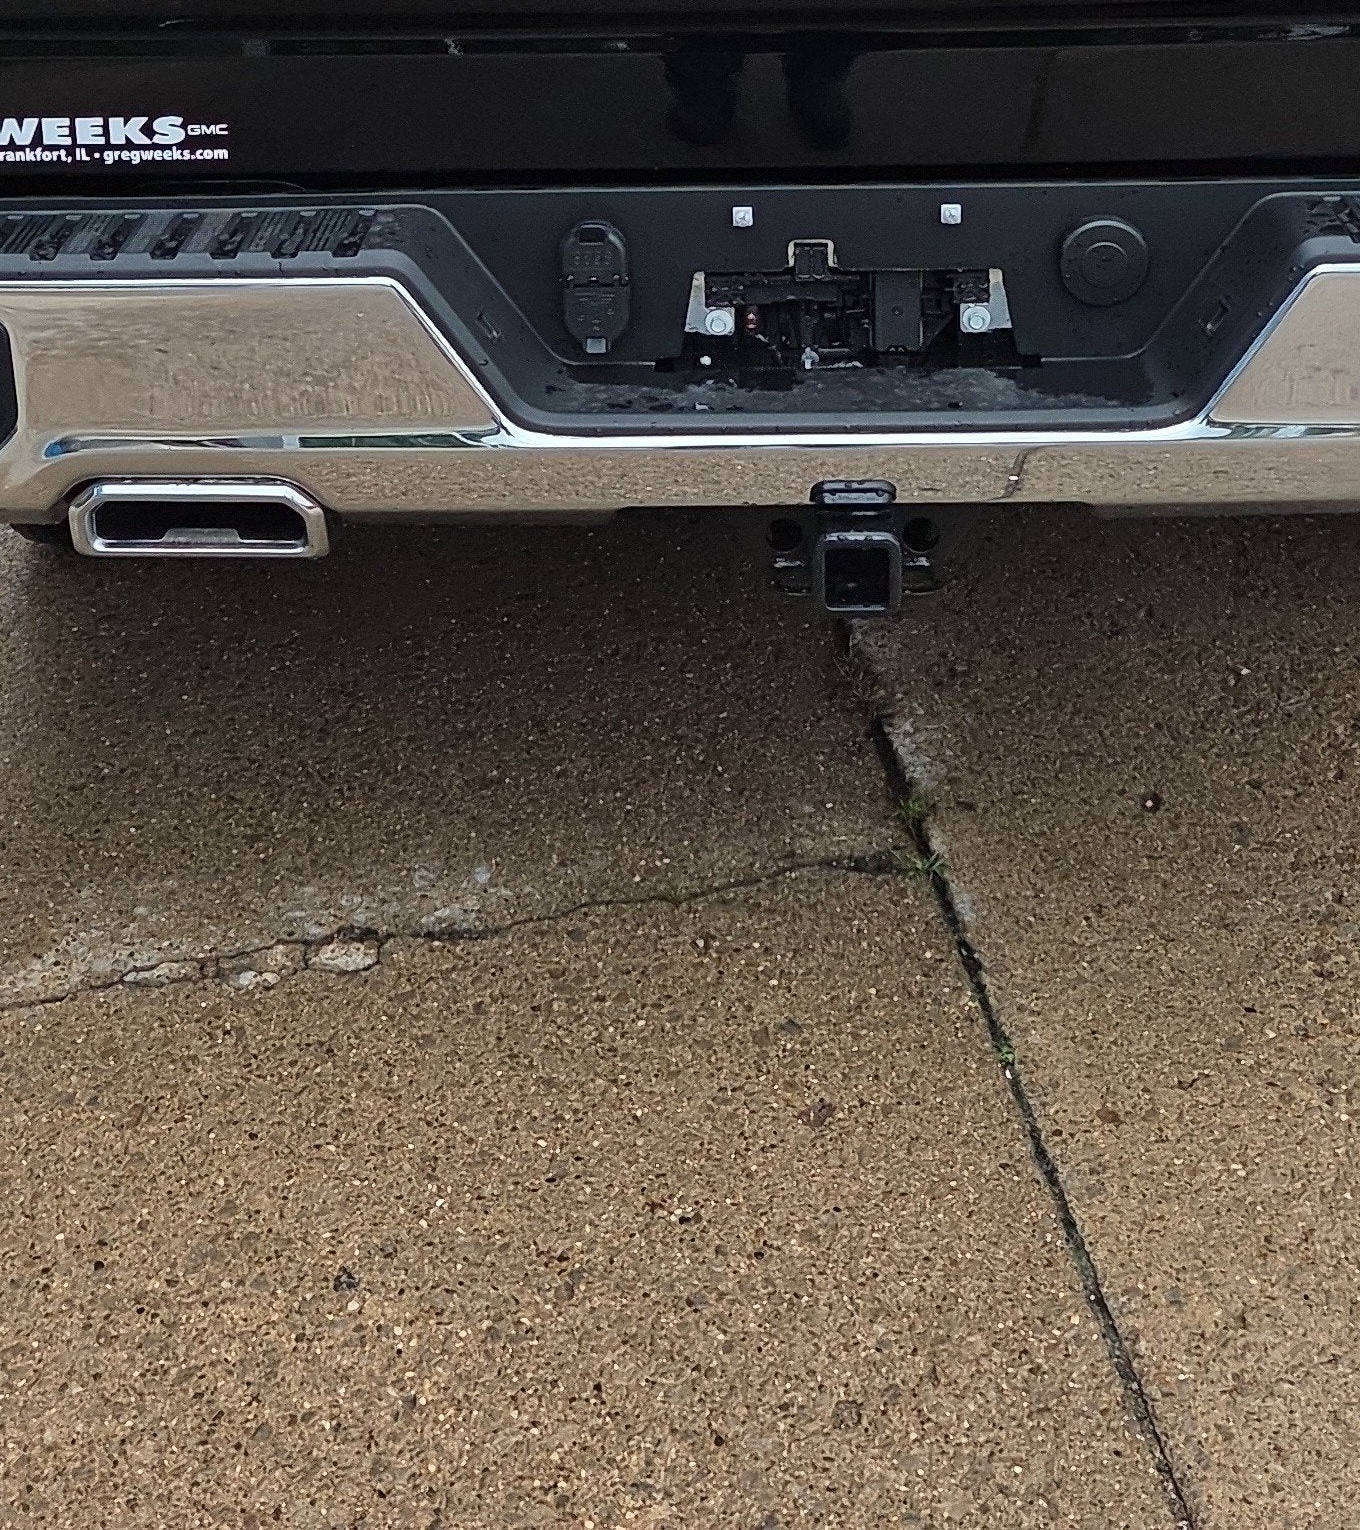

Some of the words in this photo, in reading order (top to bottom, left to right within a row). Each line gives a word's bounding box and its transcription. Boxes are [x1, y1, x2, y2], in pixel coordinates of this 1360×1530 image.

[187, 123, 229, 136] GMC
[75, 148, 91, 161] IL
[103, 147, 229, 165] gregweeks.com
